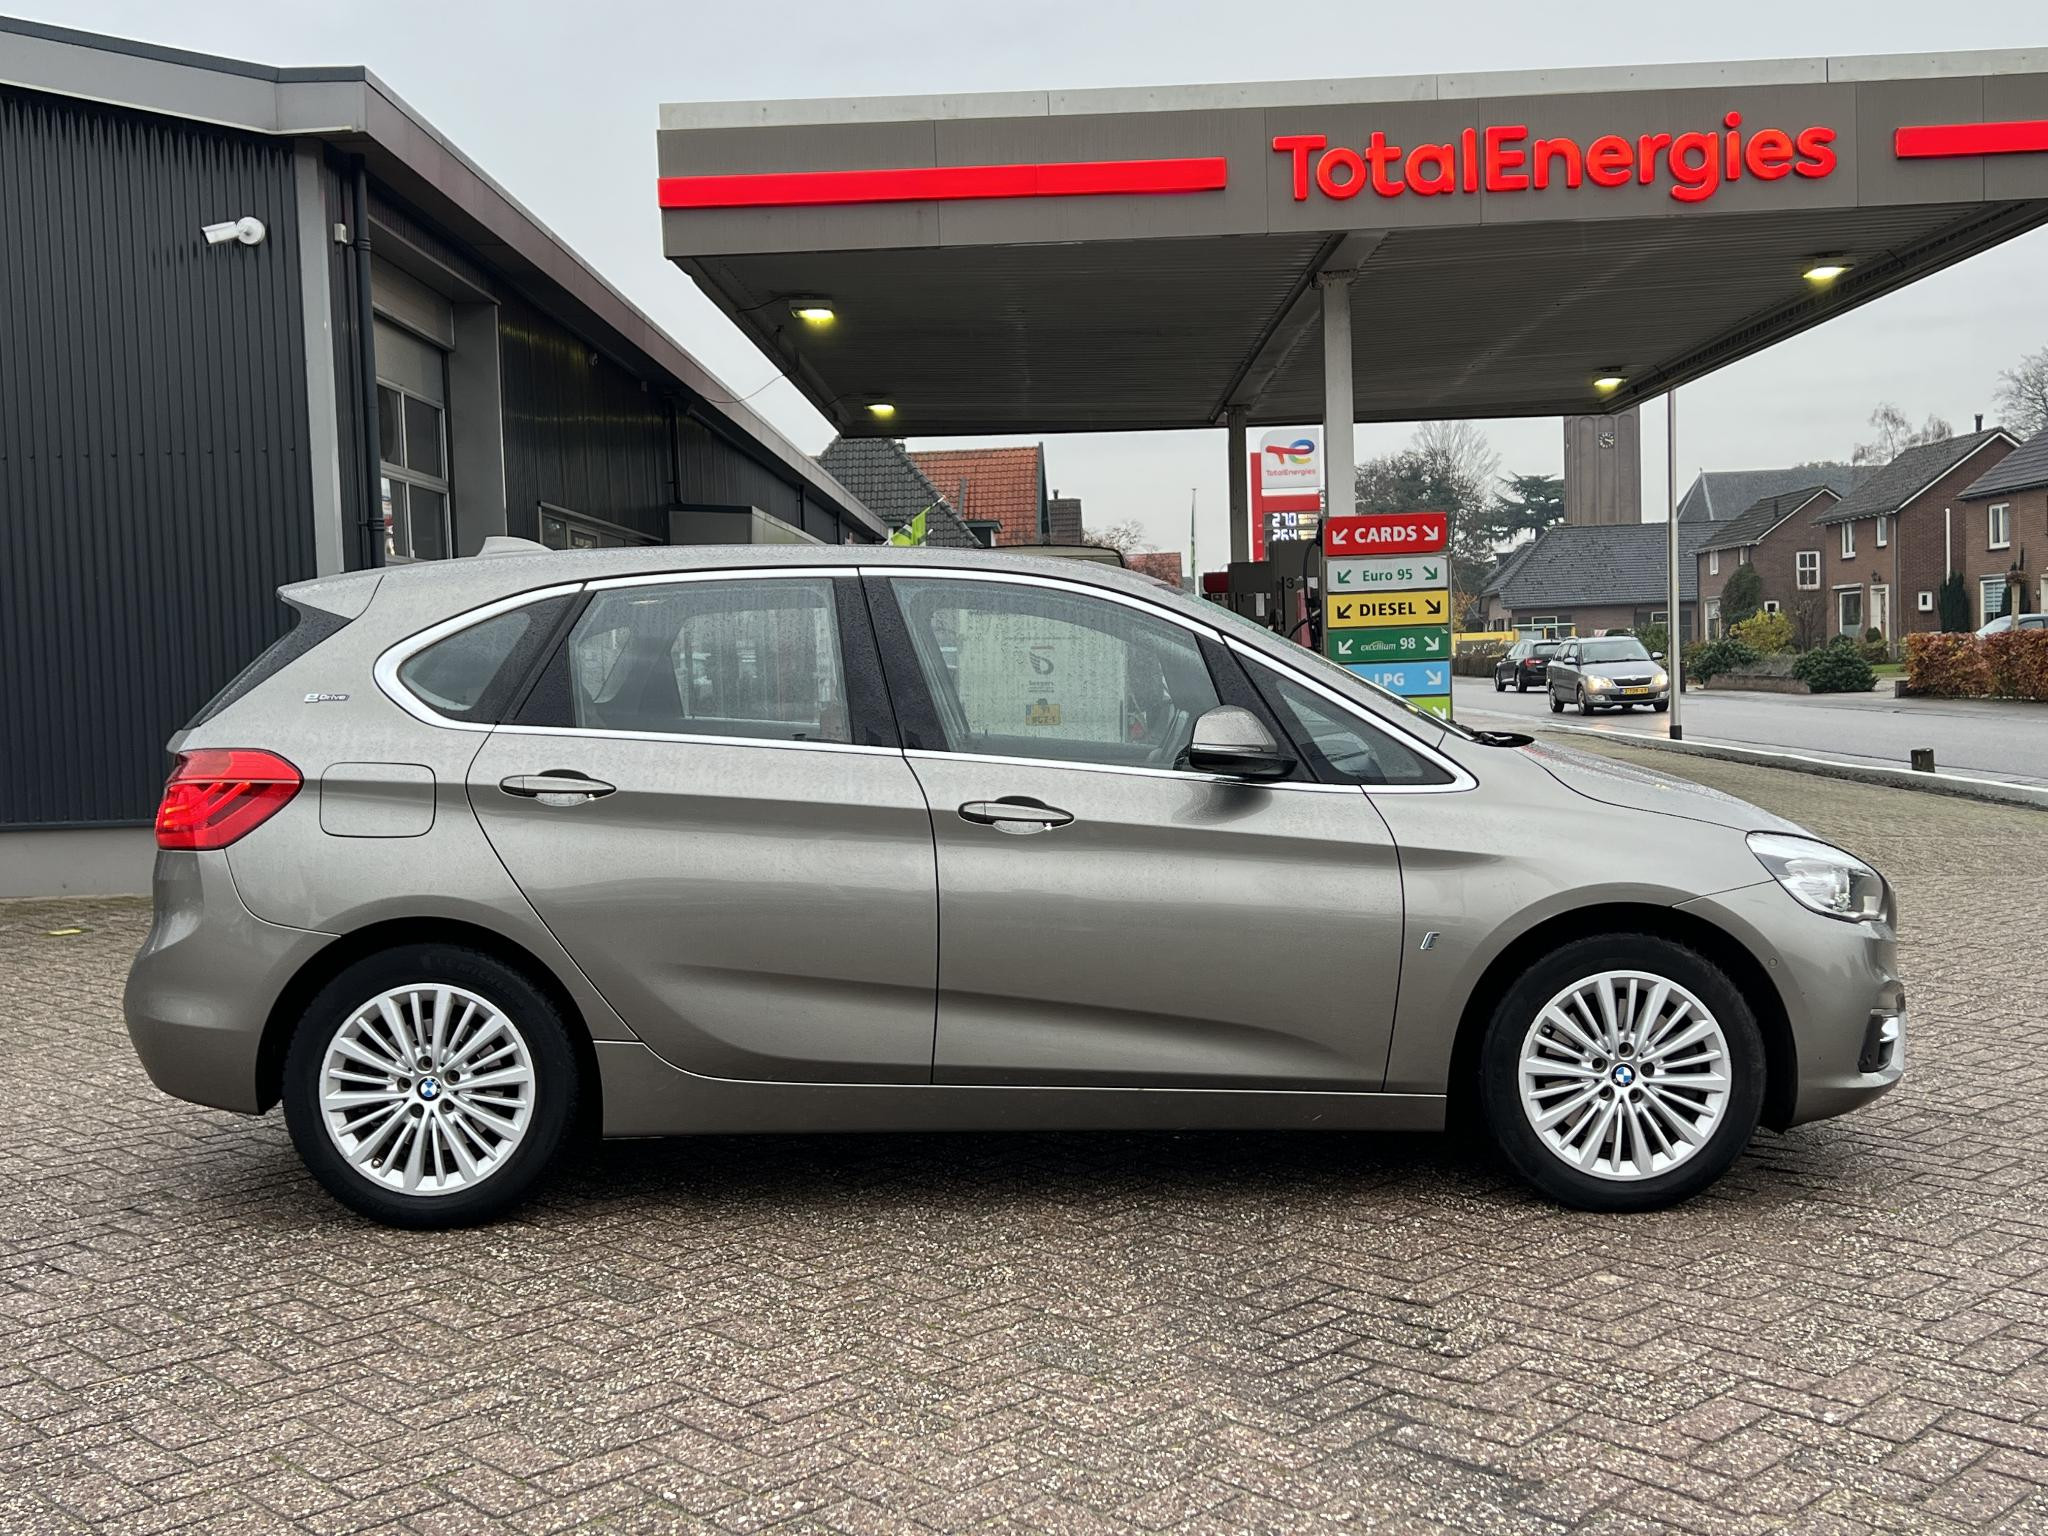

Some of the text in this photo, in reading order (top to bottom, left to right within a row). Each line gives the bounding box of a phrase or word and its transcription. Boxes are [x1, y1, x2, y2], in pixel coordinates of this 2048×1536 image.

[1272, 110, 1838, 203] TotalEnergies
[1266, 468, 1316, 477] TotalEnergies
[1354, 525, 1417, 543] CARDS
[1362, 568, 1413, 582] Euro 95
[1286, 577, 1294, 589] 3
[1359, 602, 1416, 617] DIESEL
[1400, 637, 1416, 649] 98
